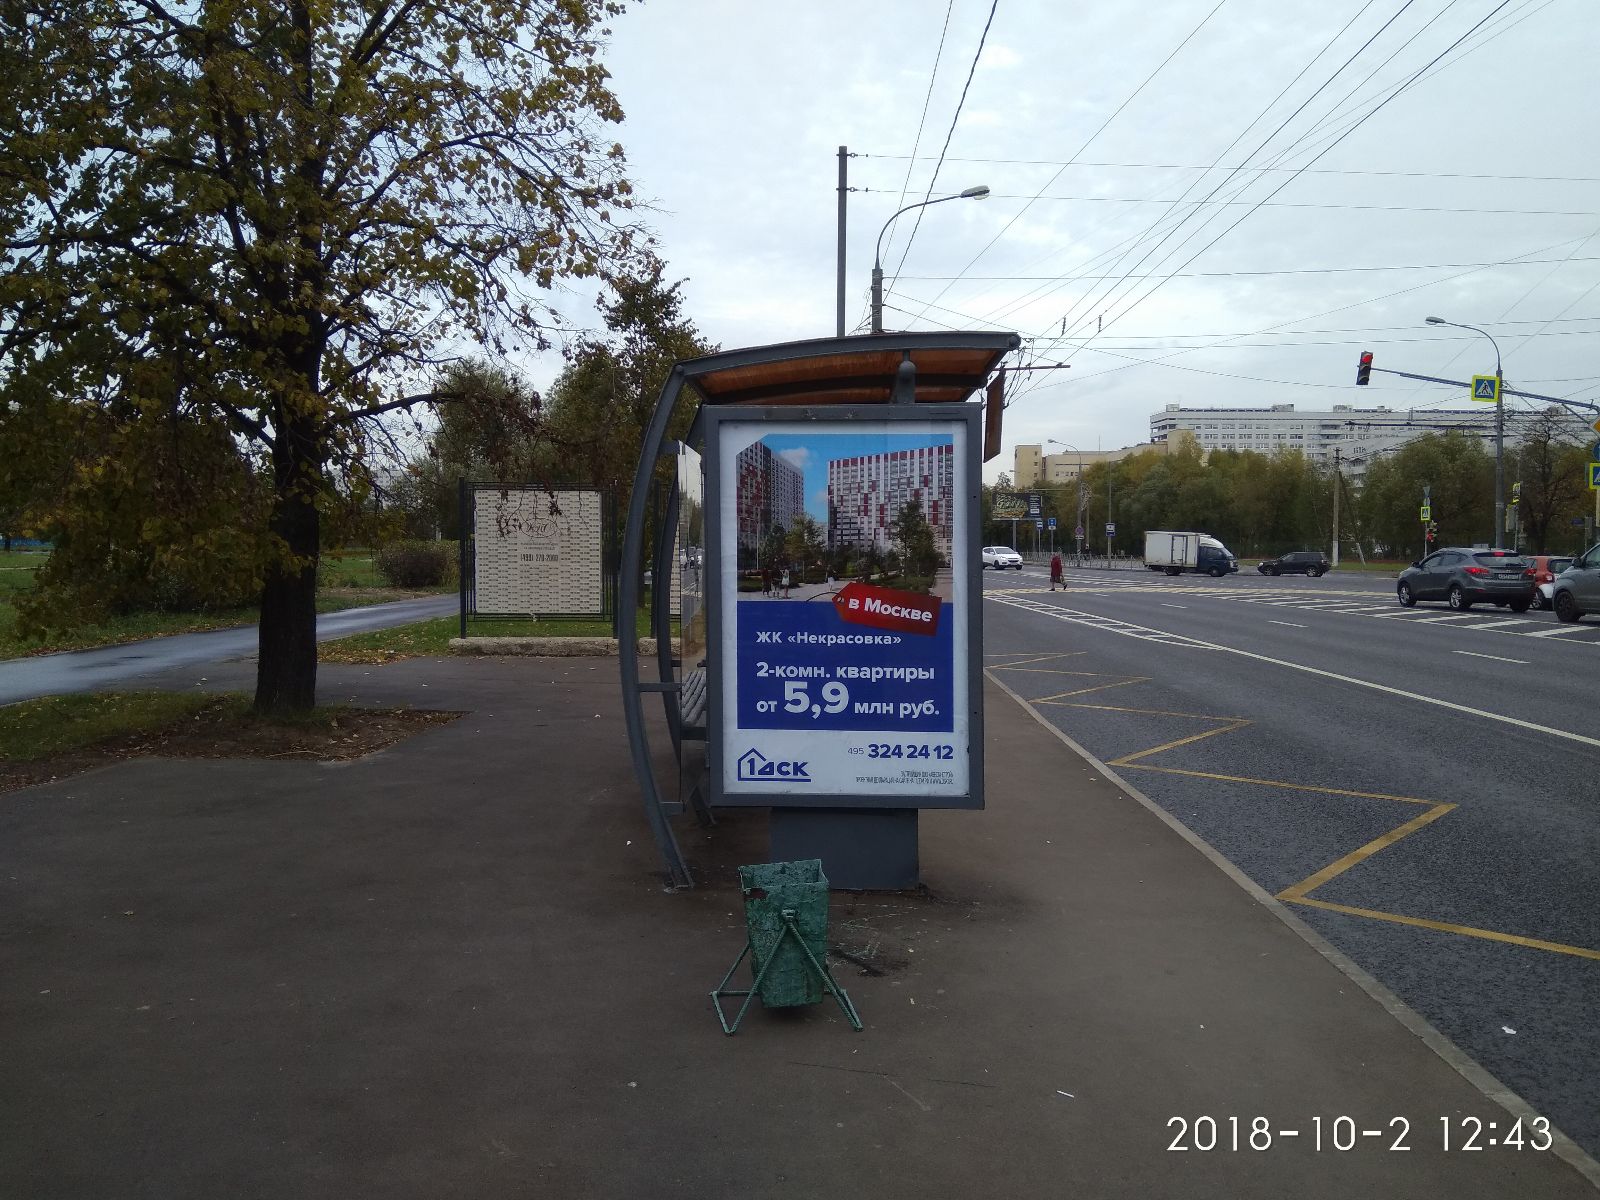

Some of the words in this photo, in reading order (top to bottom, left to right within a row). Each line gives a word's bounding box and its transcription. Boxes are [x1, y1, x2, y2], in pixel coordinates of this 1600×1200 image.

[848, 598, 860, 609] в
[864, 597, 933, 622] Москве
[756, 631, 783, 644] ЖК
[787, 631, 902, 647] «Некрасовка»
[756, 661, 831, 678] 2-комн.
[836, 666, 935, 683] квартиры
[756, 701, 778, 713] от
[784, 680, 850, 720] 5,9
[854, 702, 894, 715] млн
[899, 699, 940, 719] руб.
[847, 747, 865, 756] 495
[868, 743, 904, 759] 324
[906, 745, 931, 760] 24
[933, 745, 954, 760] 12
